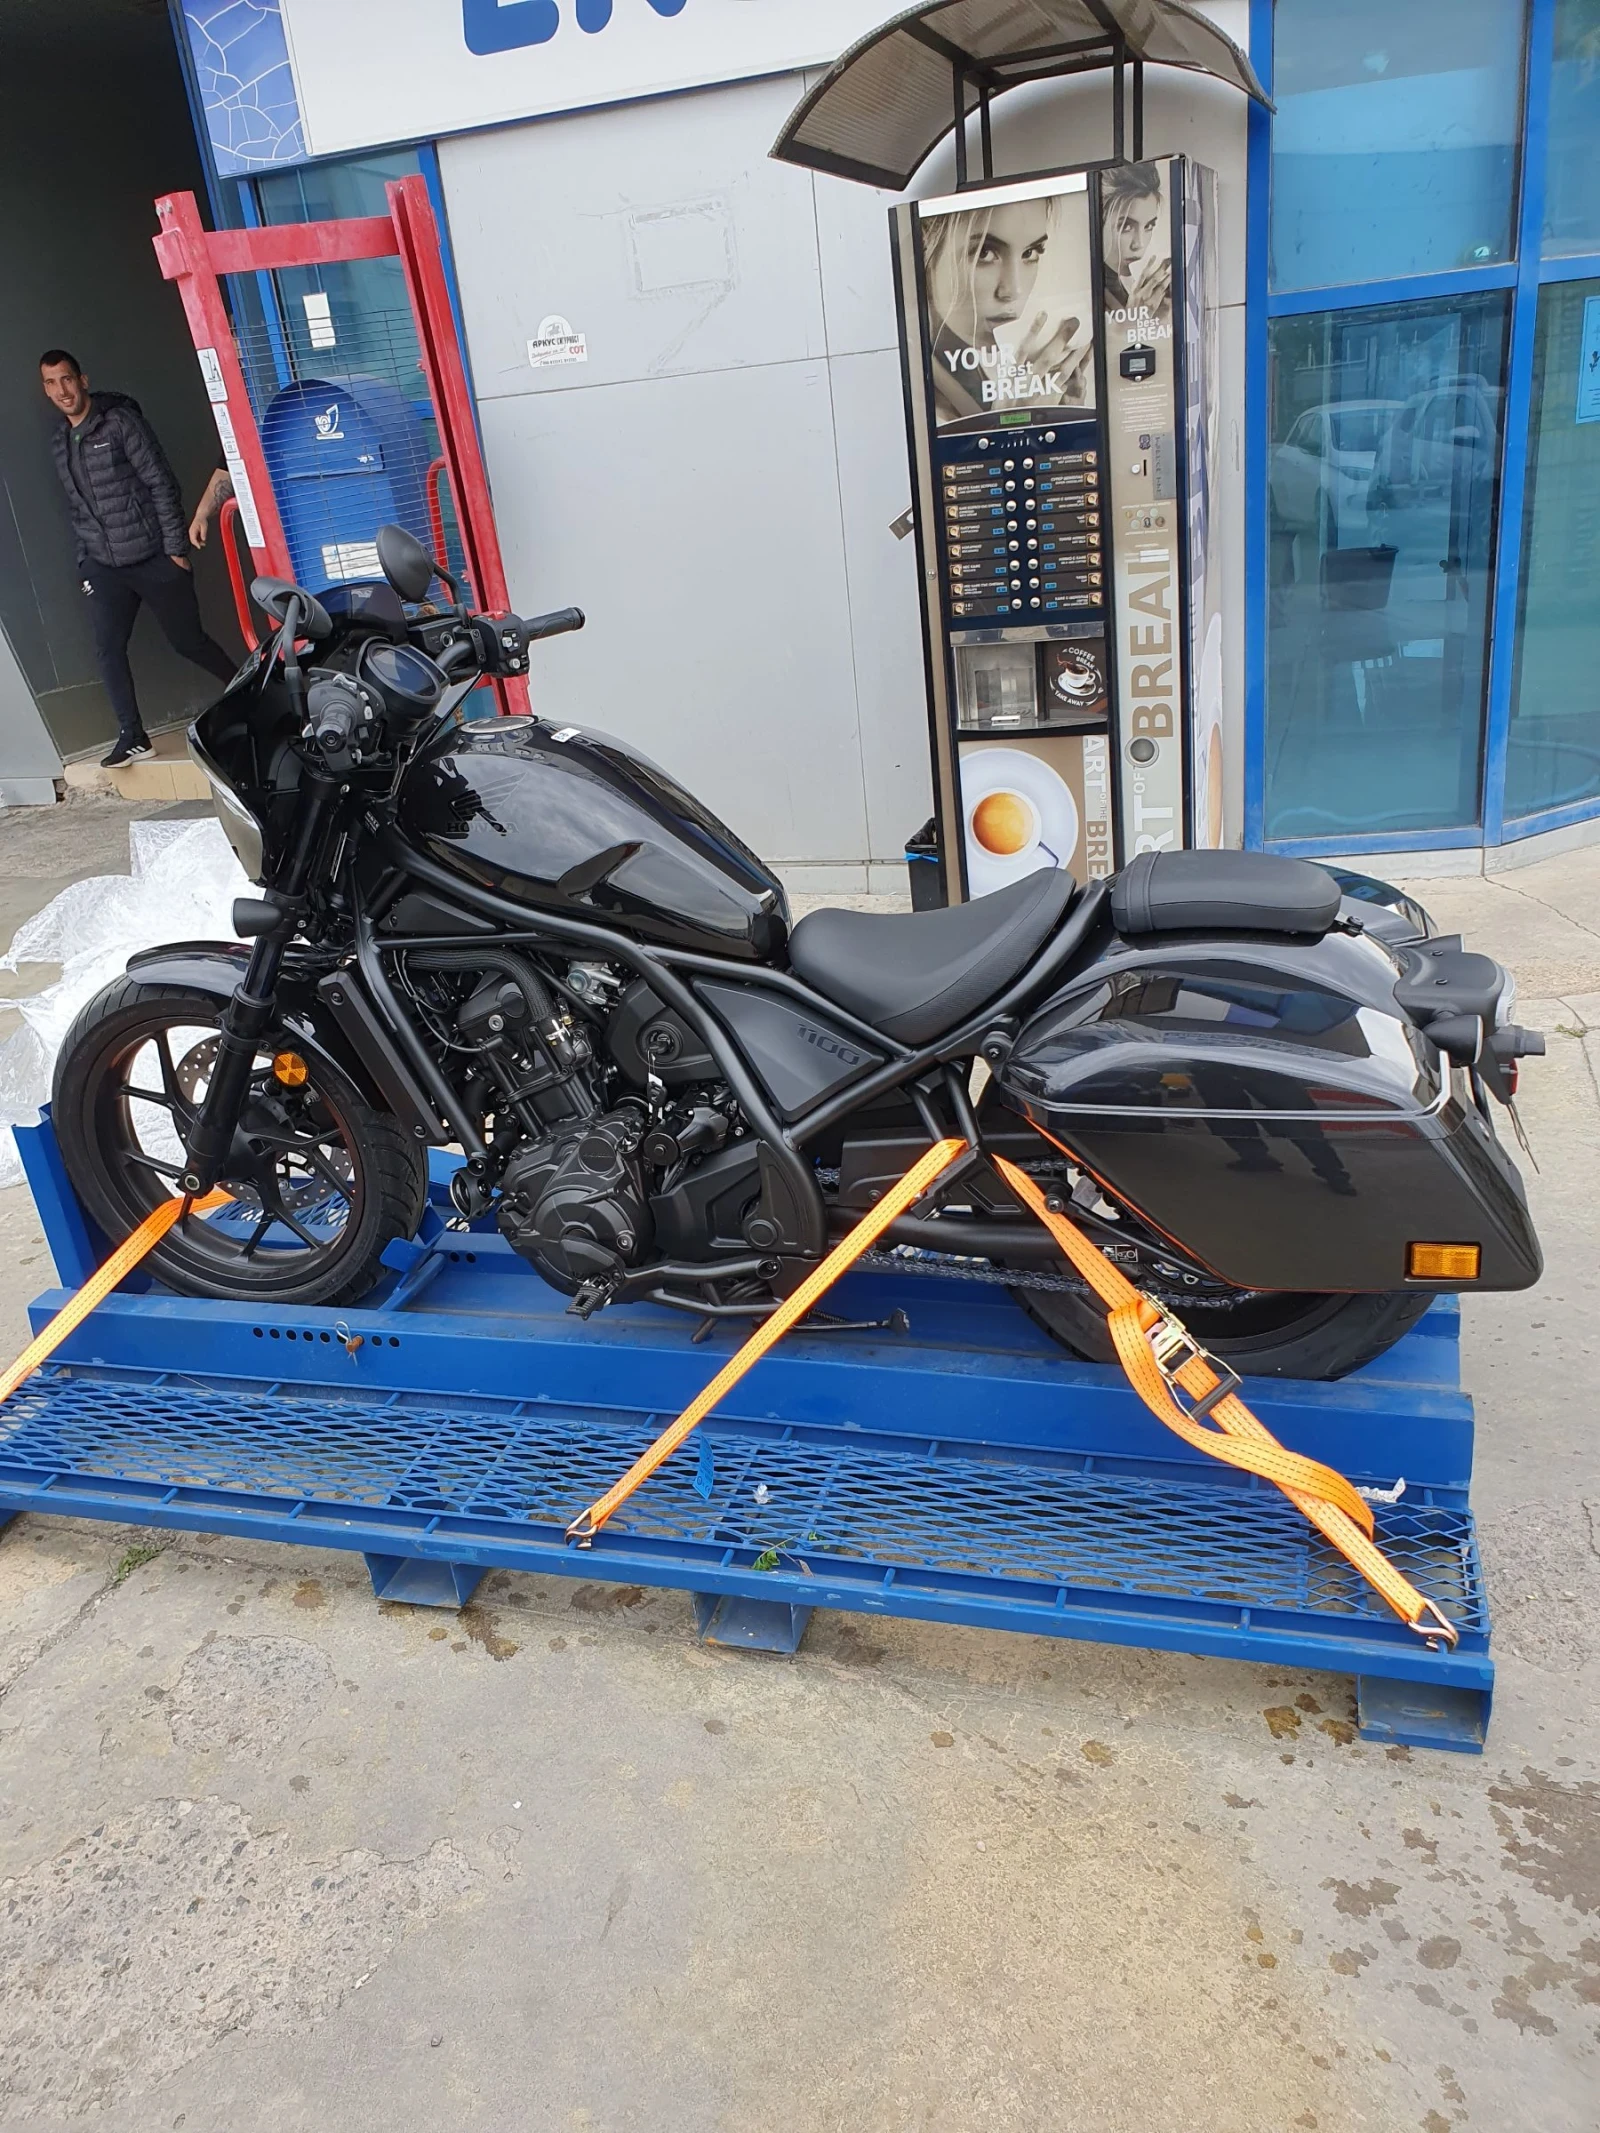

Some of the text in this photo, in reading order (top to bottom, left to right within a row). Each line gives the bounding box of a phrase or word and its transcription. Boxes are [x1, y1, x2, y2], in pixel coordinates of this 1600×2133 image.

[1105, 306, 1150, 325] YOUR
[1136, 316, 1160, 328] best
[944, 343, 1017, 373] YOUR
[997, 360, 1034, 379] best
[981, 371, 1063, 403] BREAK
[1068, 647, 1095, 662] COFFEE
[1075, 656, 1095, 670] BREAK
[1054, 690, 1085, 707] TAKE AWAY
[1083, 735, 1107, 793] ART
[1099, 805, 1107, 820] THE
[1133, 773, 1146, 794] OF
[797, 1024, 860, 1066] 1100
